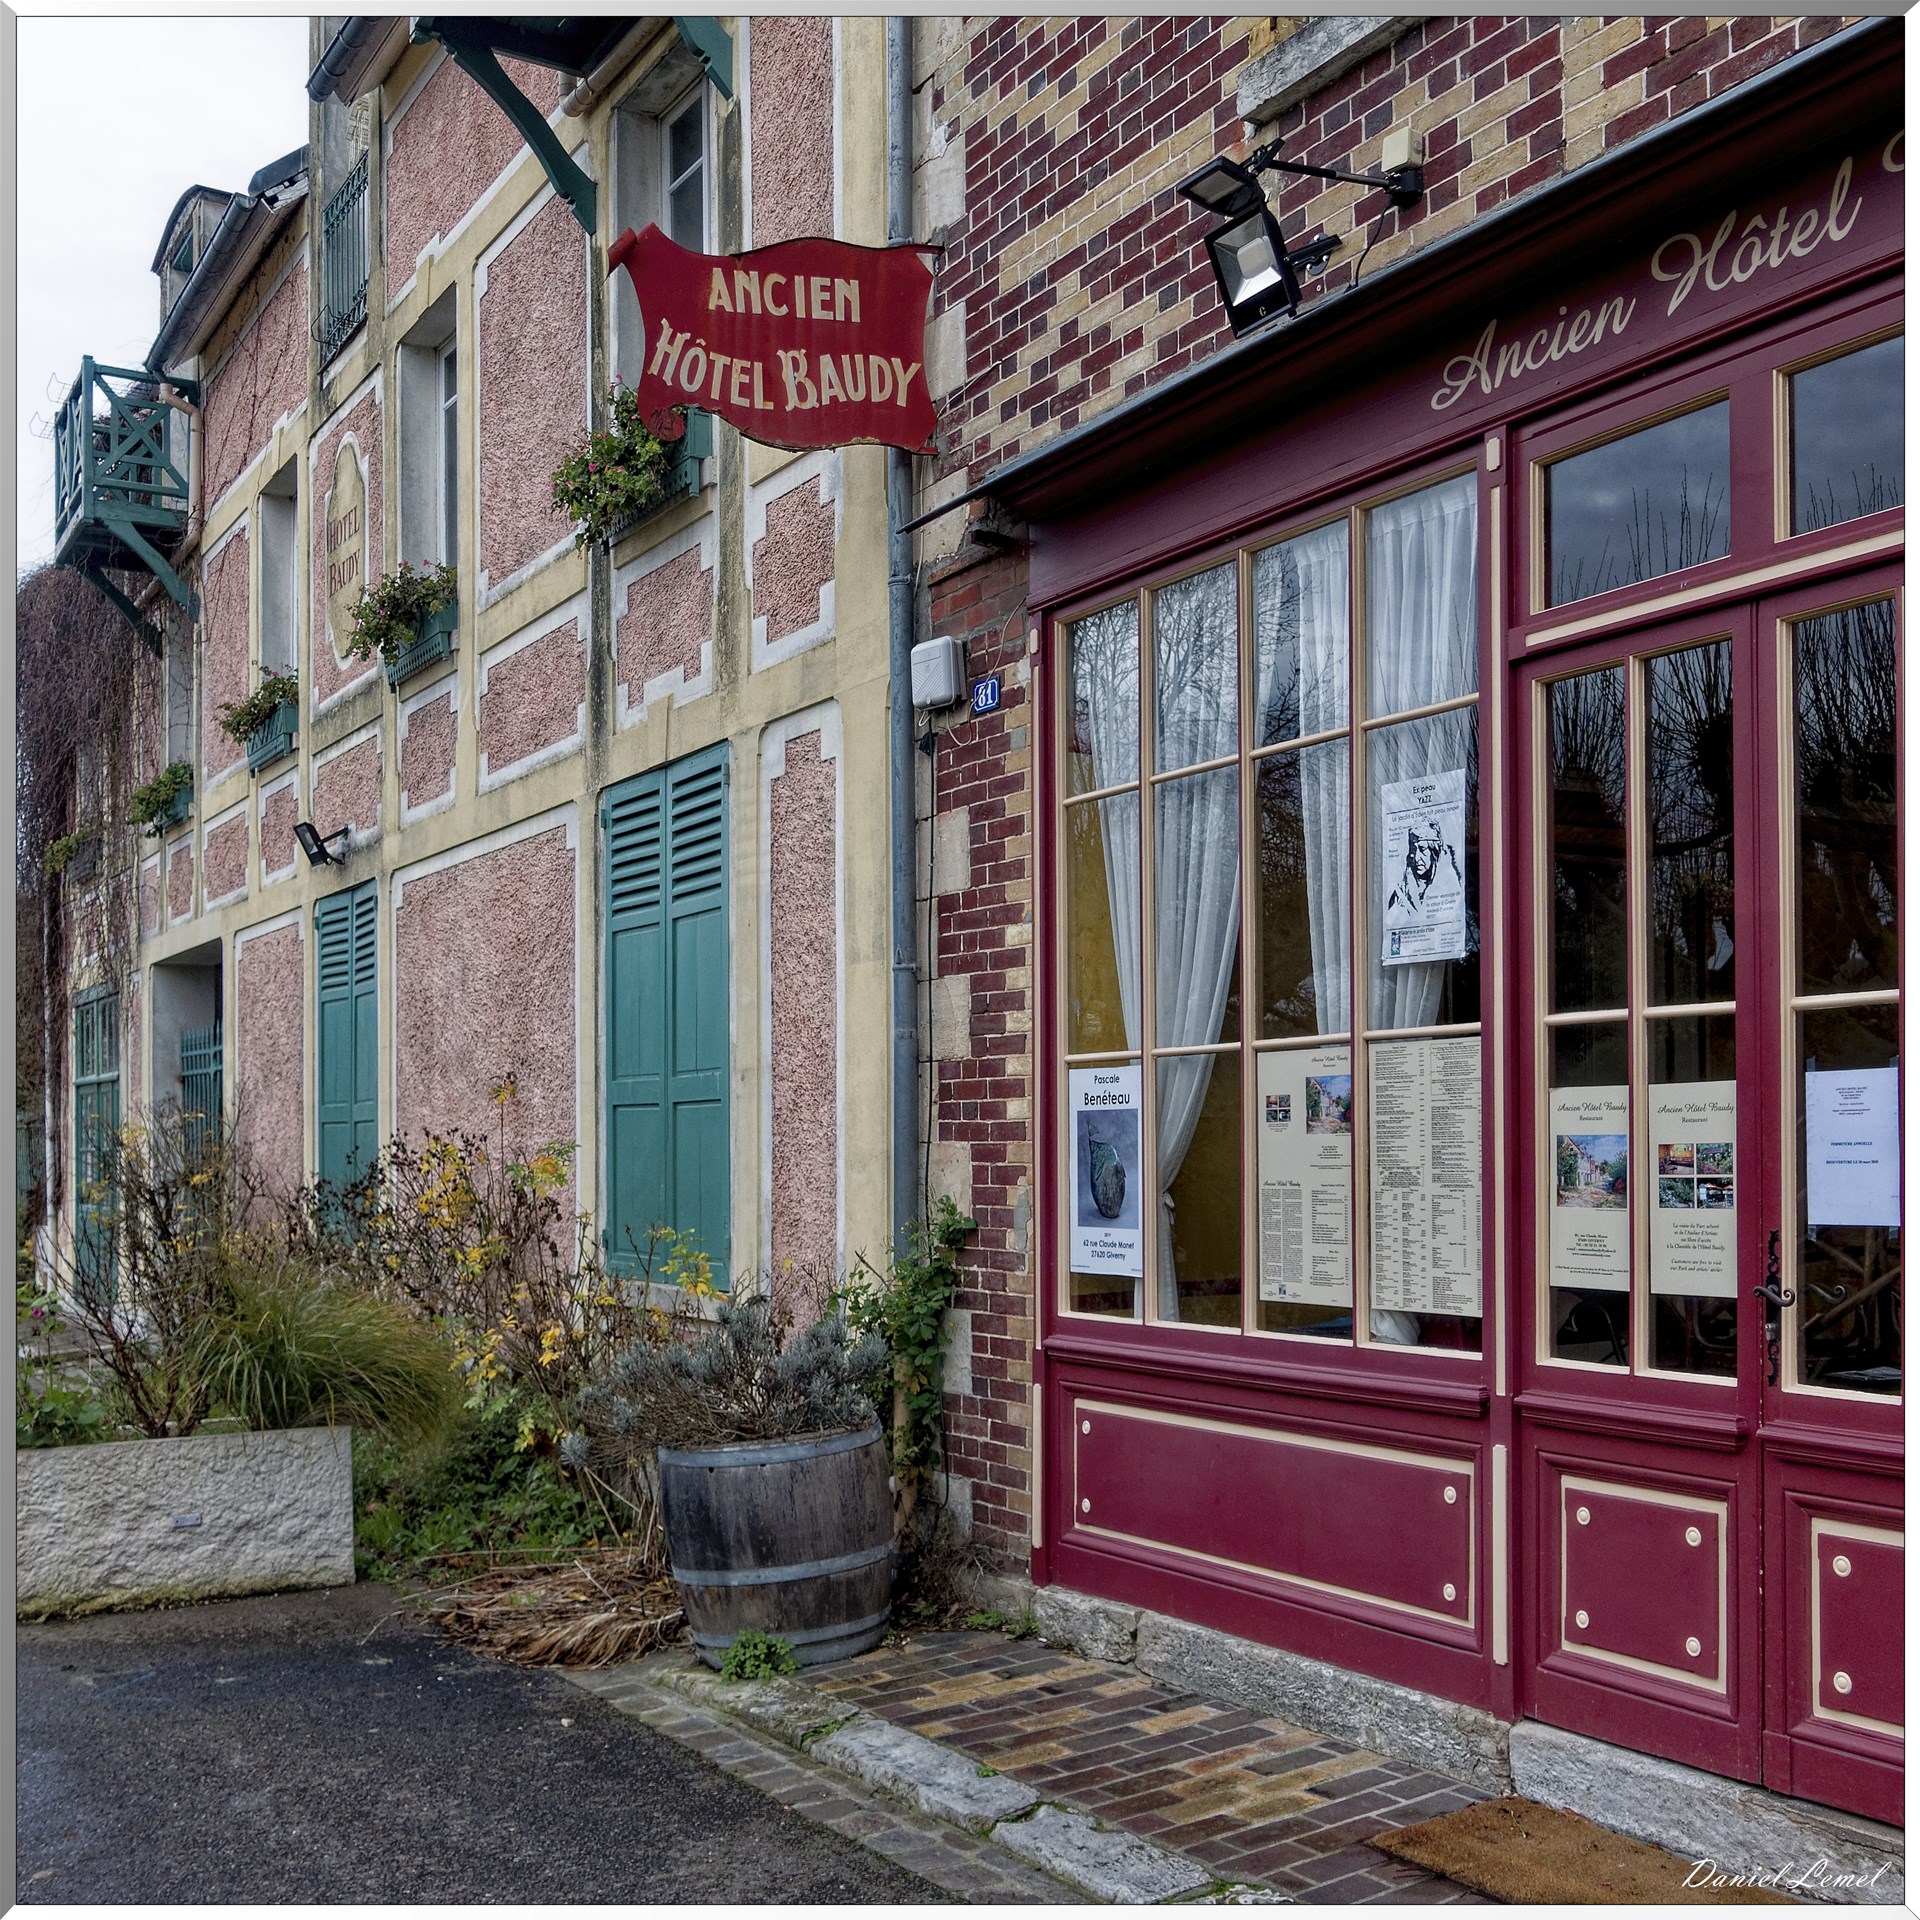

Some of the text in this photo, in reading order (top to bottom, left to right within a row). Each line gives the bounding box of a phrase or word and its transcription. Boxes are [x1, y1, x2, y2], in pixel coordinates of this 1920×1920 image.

[1431, 156, 1862, 411] Ancien Hôtel
[708, 268, 860, 323] ANCIEN
[648, 318, 922, 412] HÔTEL BAUDY
[329, 548, 360, 598] BAUDY
[1421, 784, 1436, 794] peau
[1094, 1074, 1120, 1085] Pascale
[1084, 1090, 1130, 1106] Benéteau
[1557, 1102, 1626, 1113] Ancien Hôtel Baudy
[1658, 1103, 1734, 1114] Ancien Hôtel Baudy
[1083, 1239, 1089, 1247] 62
[1099, 1240, 1117, 1248] Claude
[1118, 1241, 1134, 1249] Monet
[1091, 1250, 1126, 1261] 27620 Giverny
